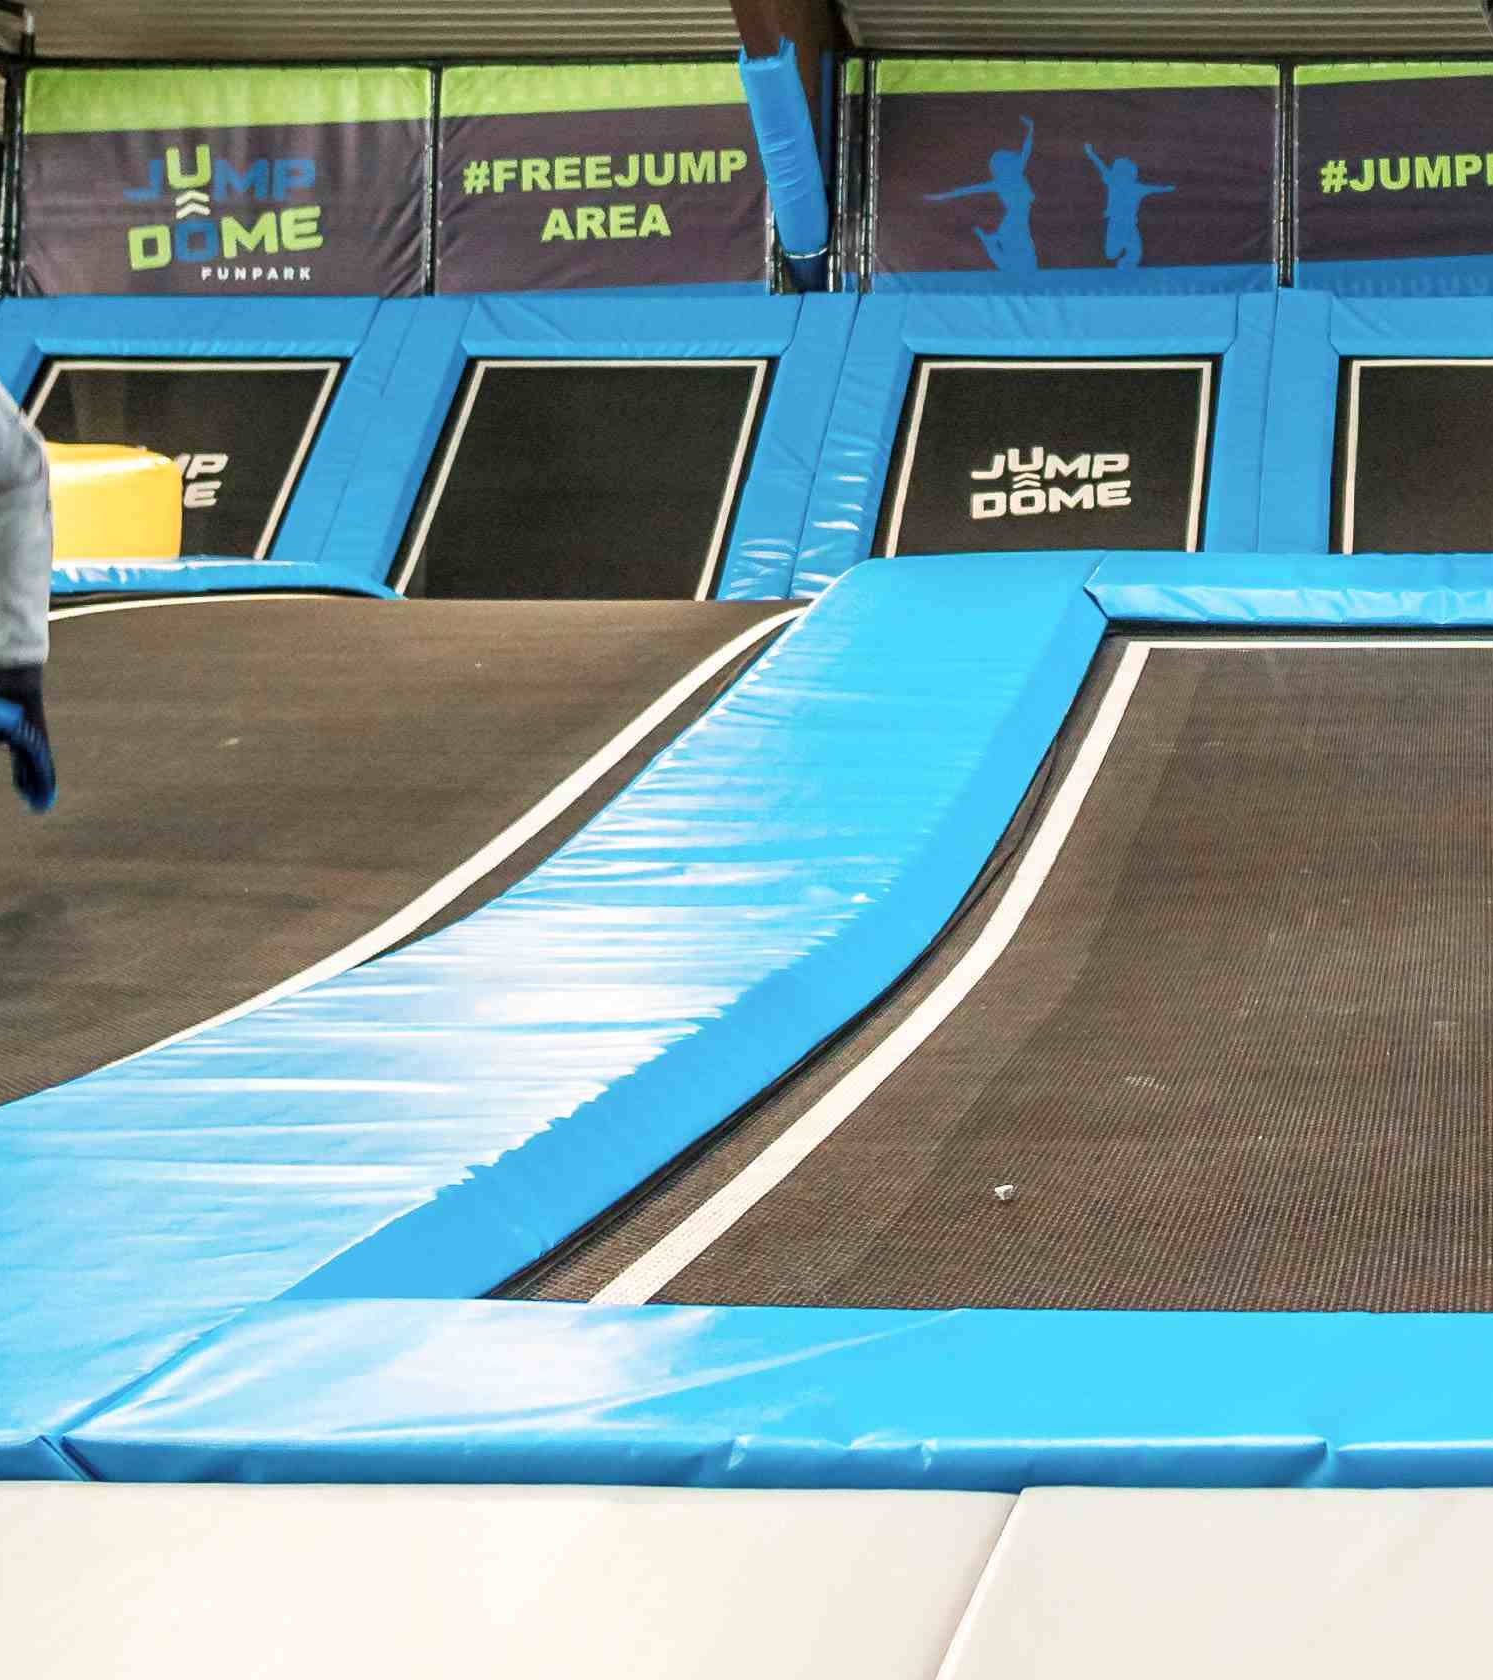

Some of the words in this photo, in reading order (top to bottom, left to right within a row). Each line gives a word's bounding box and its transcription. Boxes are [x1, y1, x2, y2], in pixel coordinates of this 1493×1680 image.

[123, 144, 316, 202] JUMP
[463, 149, 748, 195] #FREEJUMP
[128, 206, 324, 271] DOME
[540, 203, 672, 242] AREA
[201, 266, 311, 281] FUNPARK
[971, 446, 1130, 480] JUMP
[971, 480, 1132, 519] DOME
